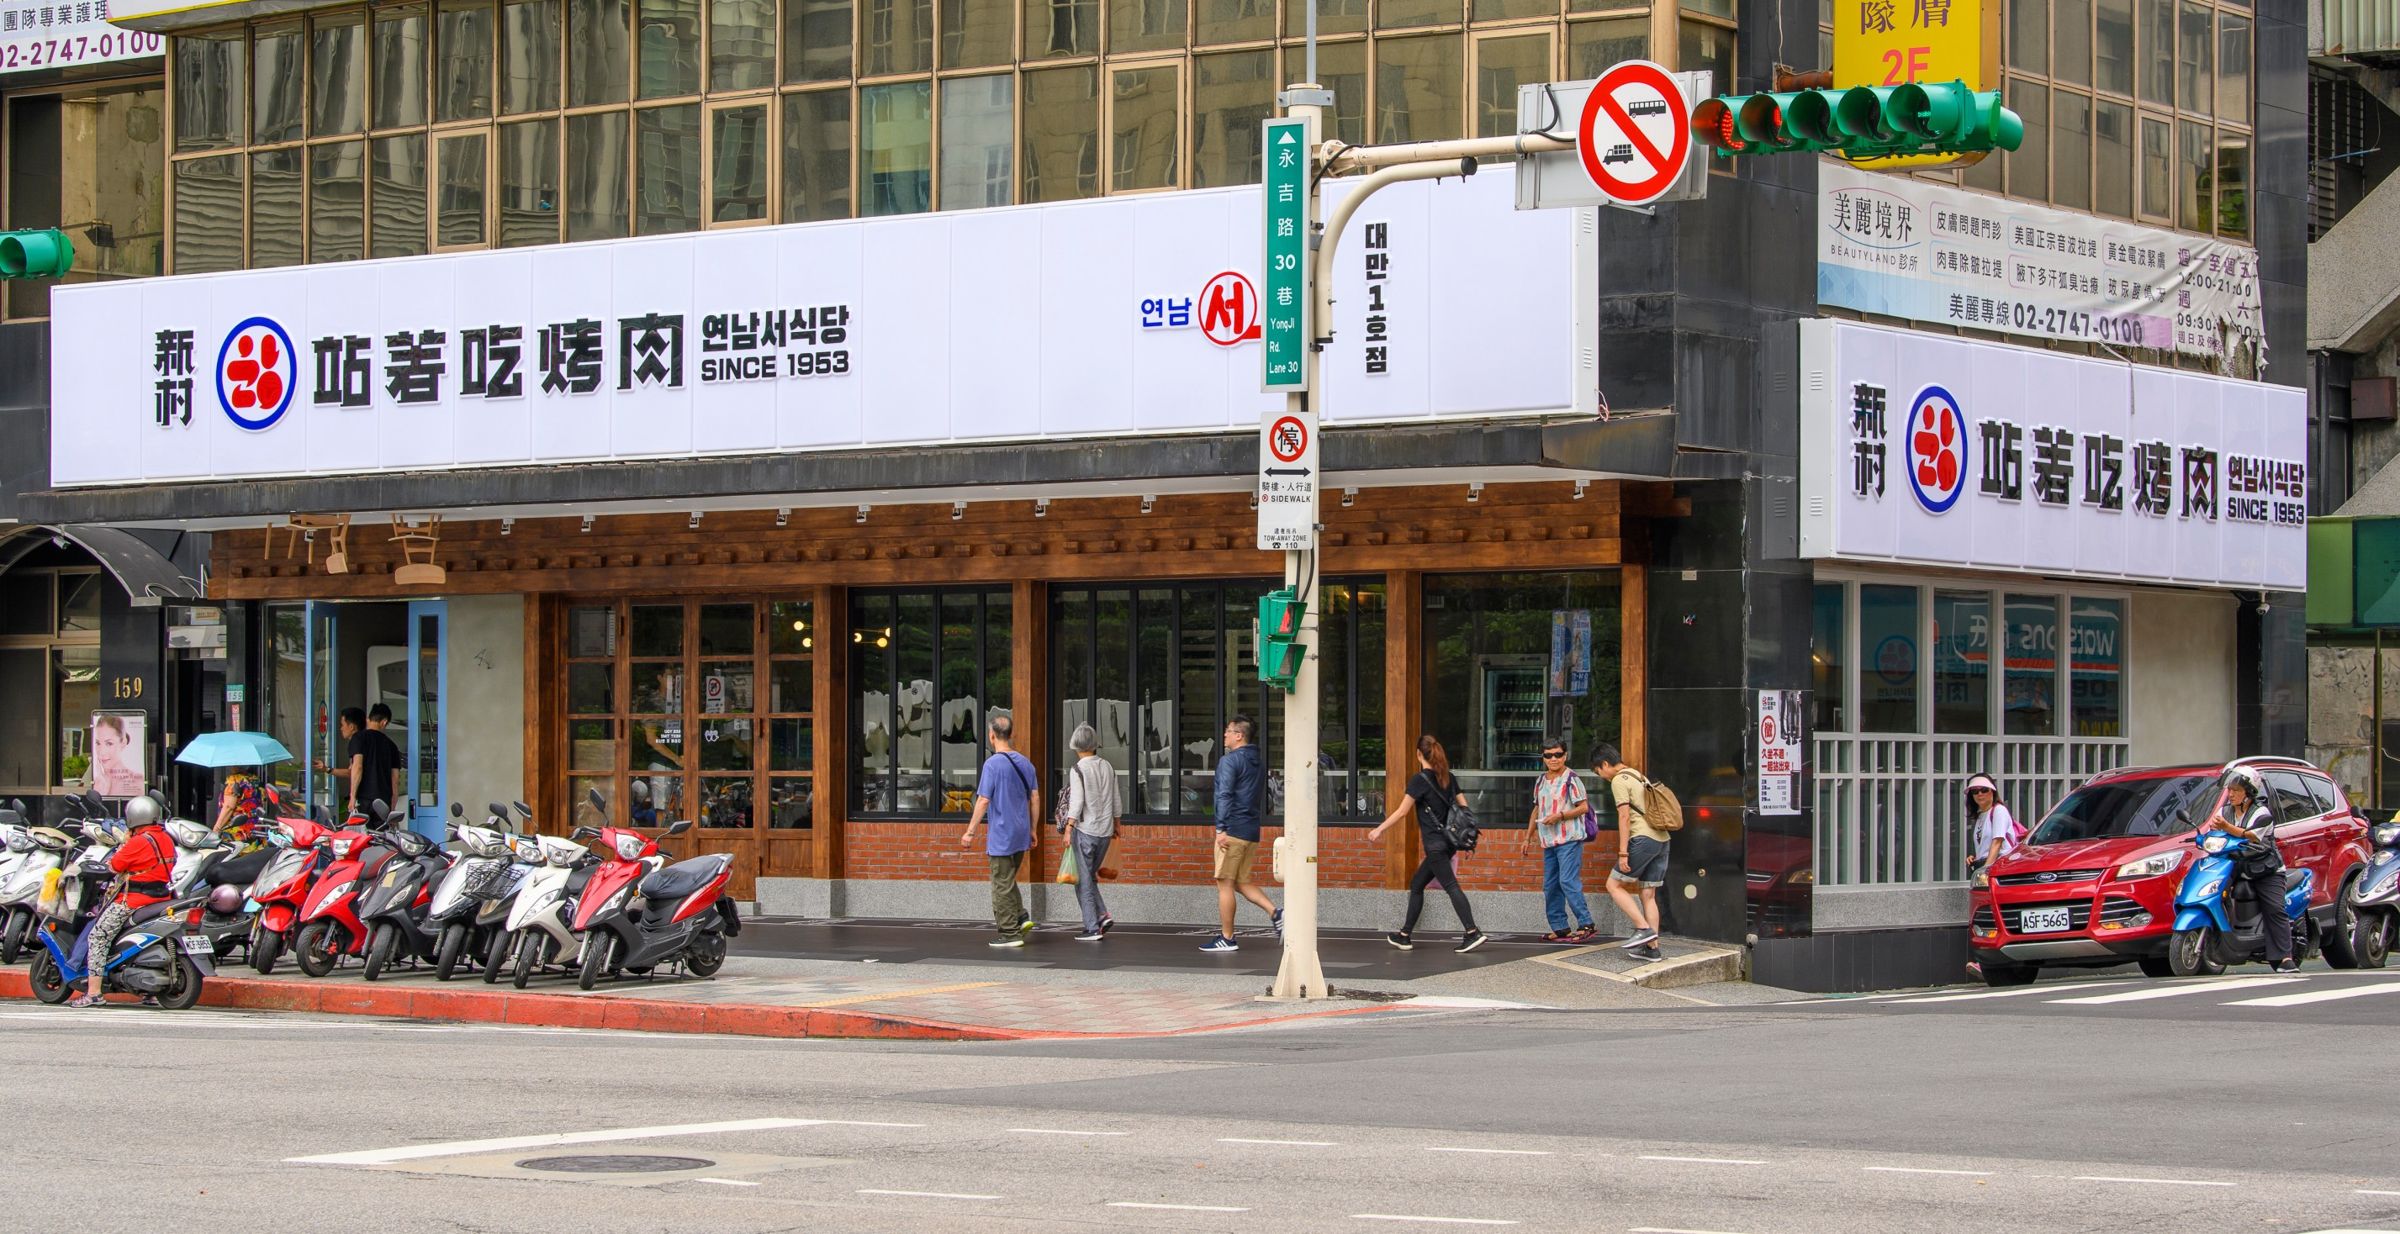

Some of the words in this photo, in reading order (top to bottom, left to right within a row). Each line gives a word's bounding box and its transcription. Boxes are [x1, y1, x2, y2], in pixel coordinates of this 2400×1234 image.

[0, 31, 160, 68] 2-2747-0100
[1882, 46, 1931, 87] 2F
[1834, 192, 1912, 242] 美麗境界
[1937, 211, 2001, 240] 皮膚問題門診
[2015, 226, 2096, 258] 美國正宗音波拉提
[1831, 244, 1896, 265] BEAUTYLAND
[1899, 253, 1918, 273] 診所
[1937, 250, 2002, 278] 肉毒除皺拉提
[2016, 263, 2099, 295] 腋下多汗狐臭治療
[1365, 222, 1389, 374] 대만1호점
[702, 305, 850, 352] 연남서식당
[1949, 293, 2010, 326] 美麗專線
[2014, 302, 2143, 345] 02-2747-0100
[1269, 341, 1280, 352] Rd.
[154, 329, 194, 427] 新村
[701, 355, 777, 382] SINCE
[787, 350, 849, 377] 1953
[1269, 362, 1286, 374] Lane
[1288, 361, 1298, 373] 30
[1278, 426, 1299, 452] 停
[1853, 383, 1887, 498] 新村
[2228, 456, 2305, 498] 연남서식당
[2228, 497, 2268, 520] SINCE
[2274, 502, 2305, 524] 1953
[113, 677, 143, 698] 159
[2023, 913, 2068, 929] ASF-5665
